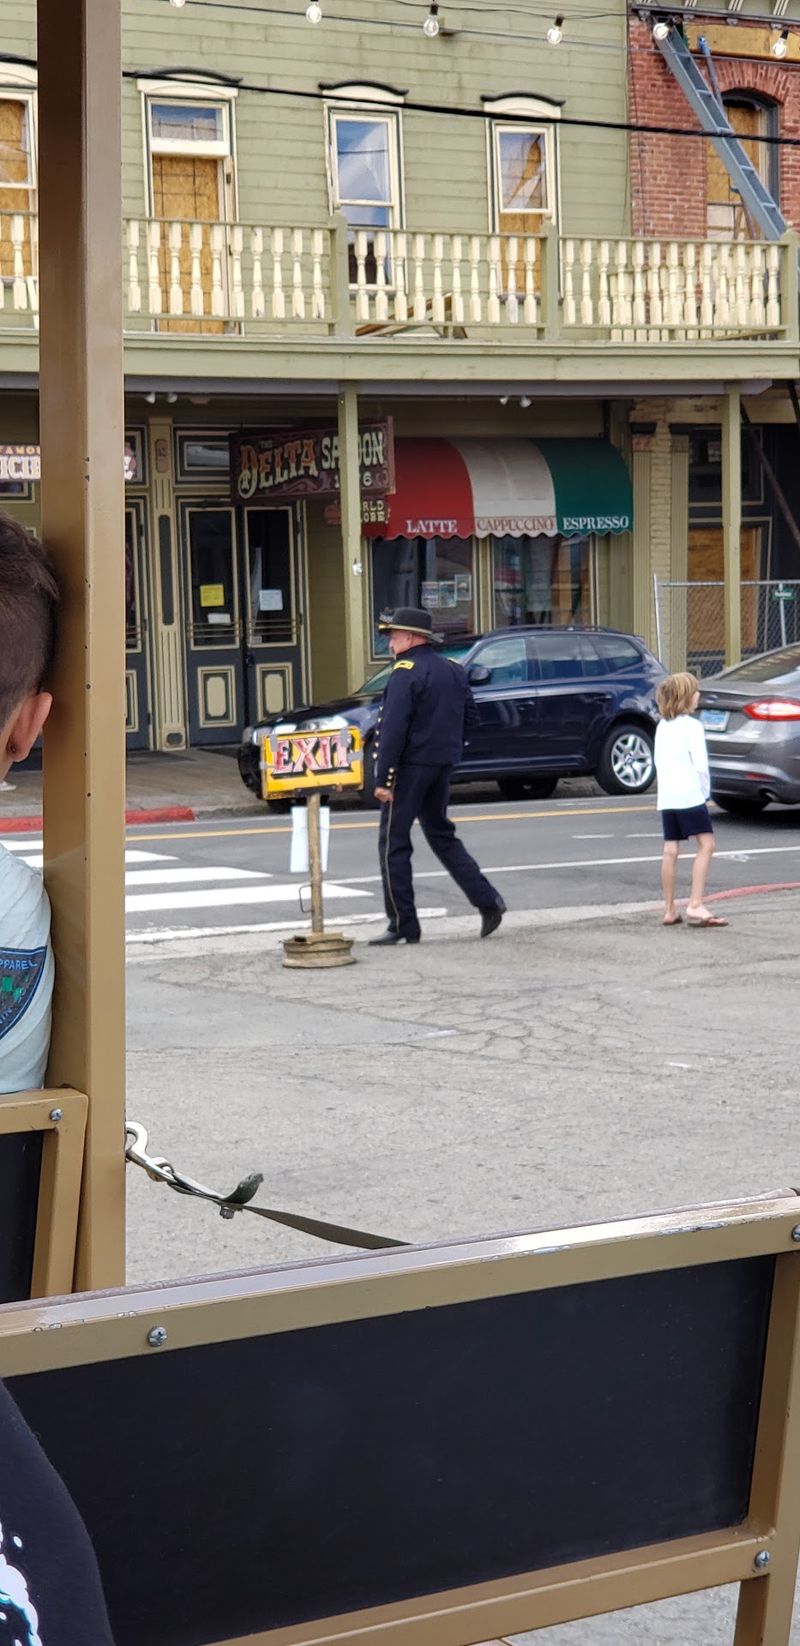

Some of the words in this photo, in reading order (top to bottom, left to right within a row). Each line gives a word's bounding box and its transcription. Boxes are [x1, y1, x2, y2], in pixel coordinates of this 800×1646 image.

[238, 439, 318, 499] DELTA
[321, 431, 384, 469] SAON
[362, 500, 384, 511] RLD
[406, 519, 458, 533] LATTE
[476, 515, 554, 532] CAPPUCCINO
[563, 516, 629, 530] ESPRESSO
[272, 734, 350, 774] EXIT
